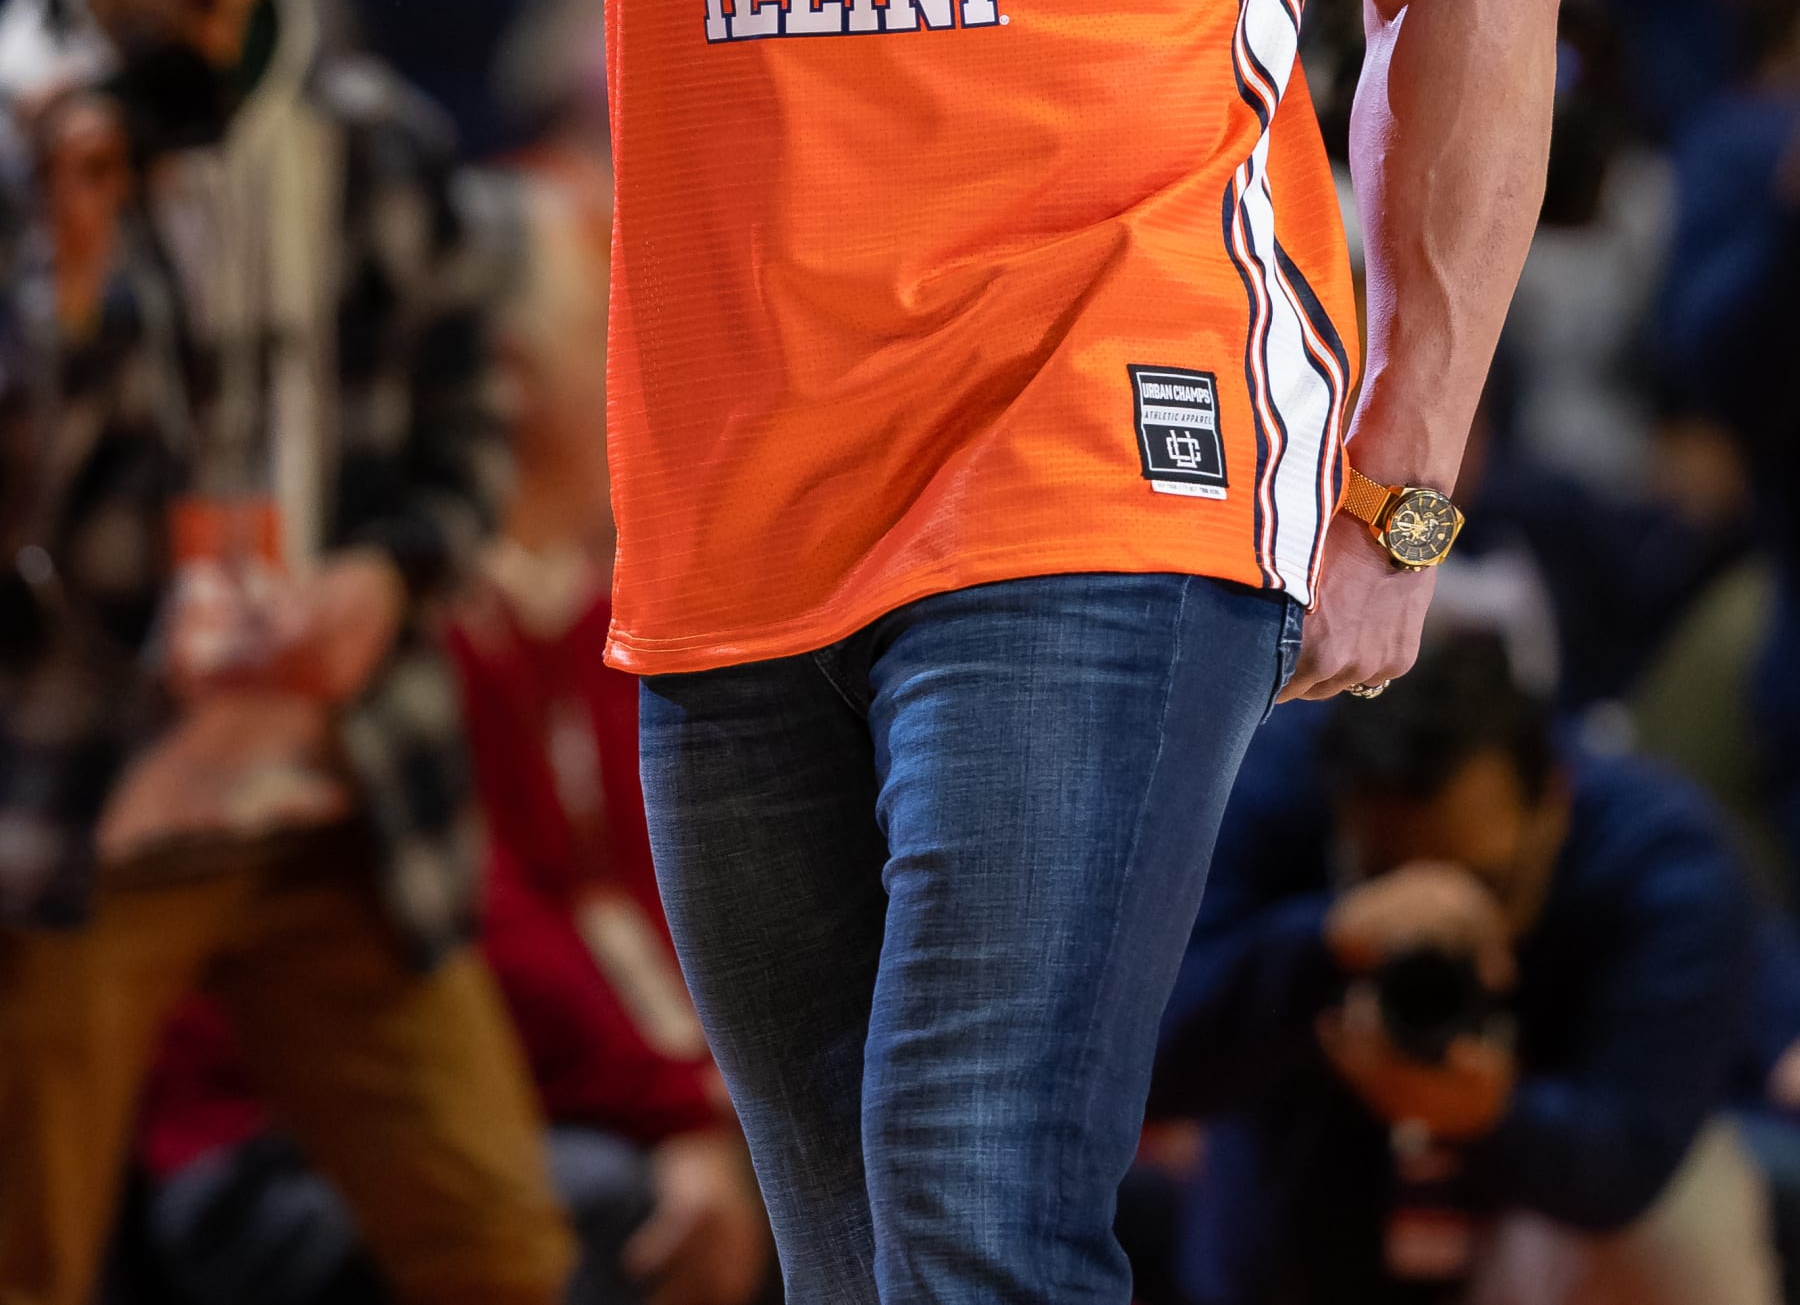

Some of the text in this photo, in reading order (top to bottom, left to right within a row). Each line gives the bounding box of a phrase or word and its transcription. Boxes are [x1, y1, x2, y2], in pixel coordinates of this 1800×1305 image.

[1142, 382, 1211, 404] URBAN CHAMPS
[1144, 410, 1212, 425] ATHLETIC APPAREL
